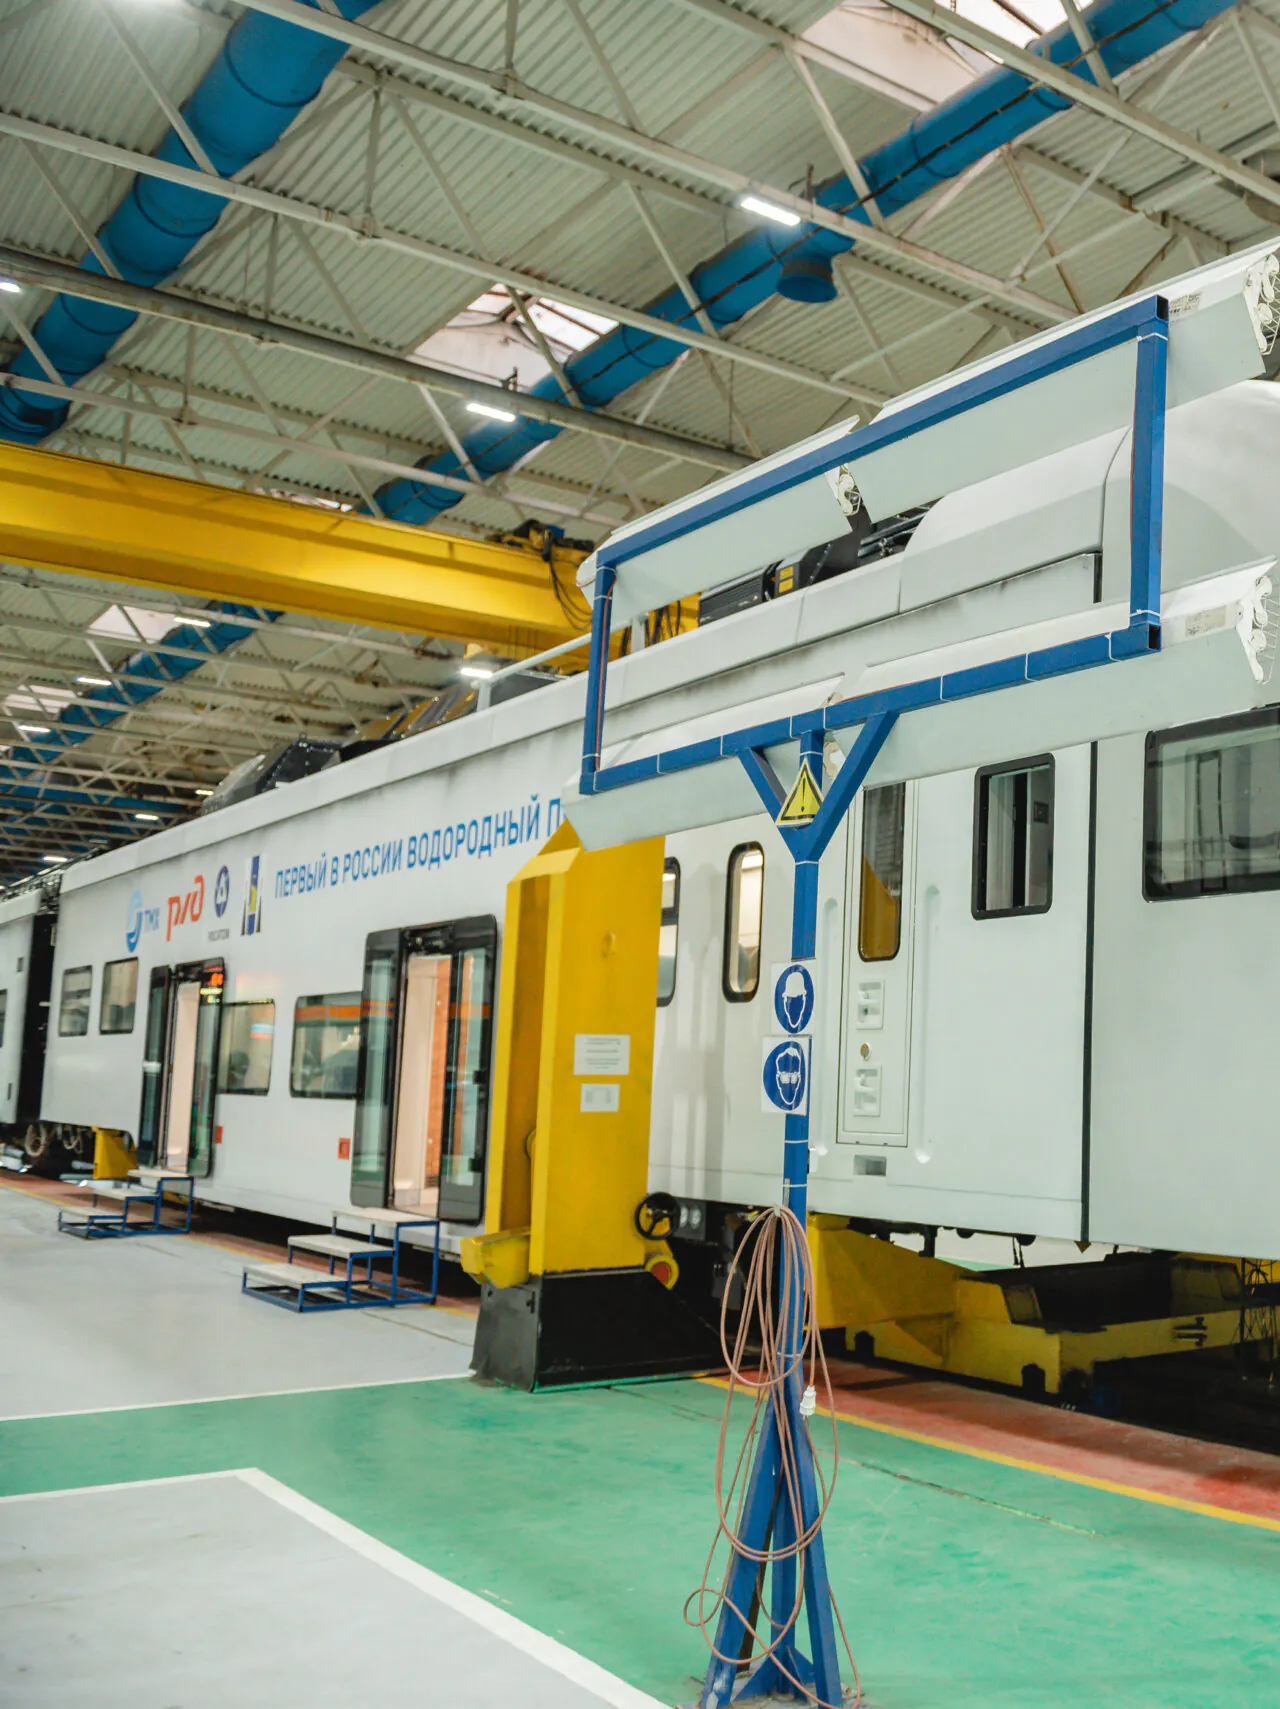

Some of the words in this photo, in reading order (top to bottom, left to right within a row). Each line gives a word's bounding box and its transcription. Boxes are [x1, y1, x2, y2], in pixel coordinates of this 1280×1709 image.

[274, 852, 327, 899] ПЕРВЫЙ
[330, 856, 339, 887] В
[342, 838, 404, 884] РОССИИ
[406, 793, 541, 871] ВОДОРОДНЫЙ
[547, 797, 567, 838] П
